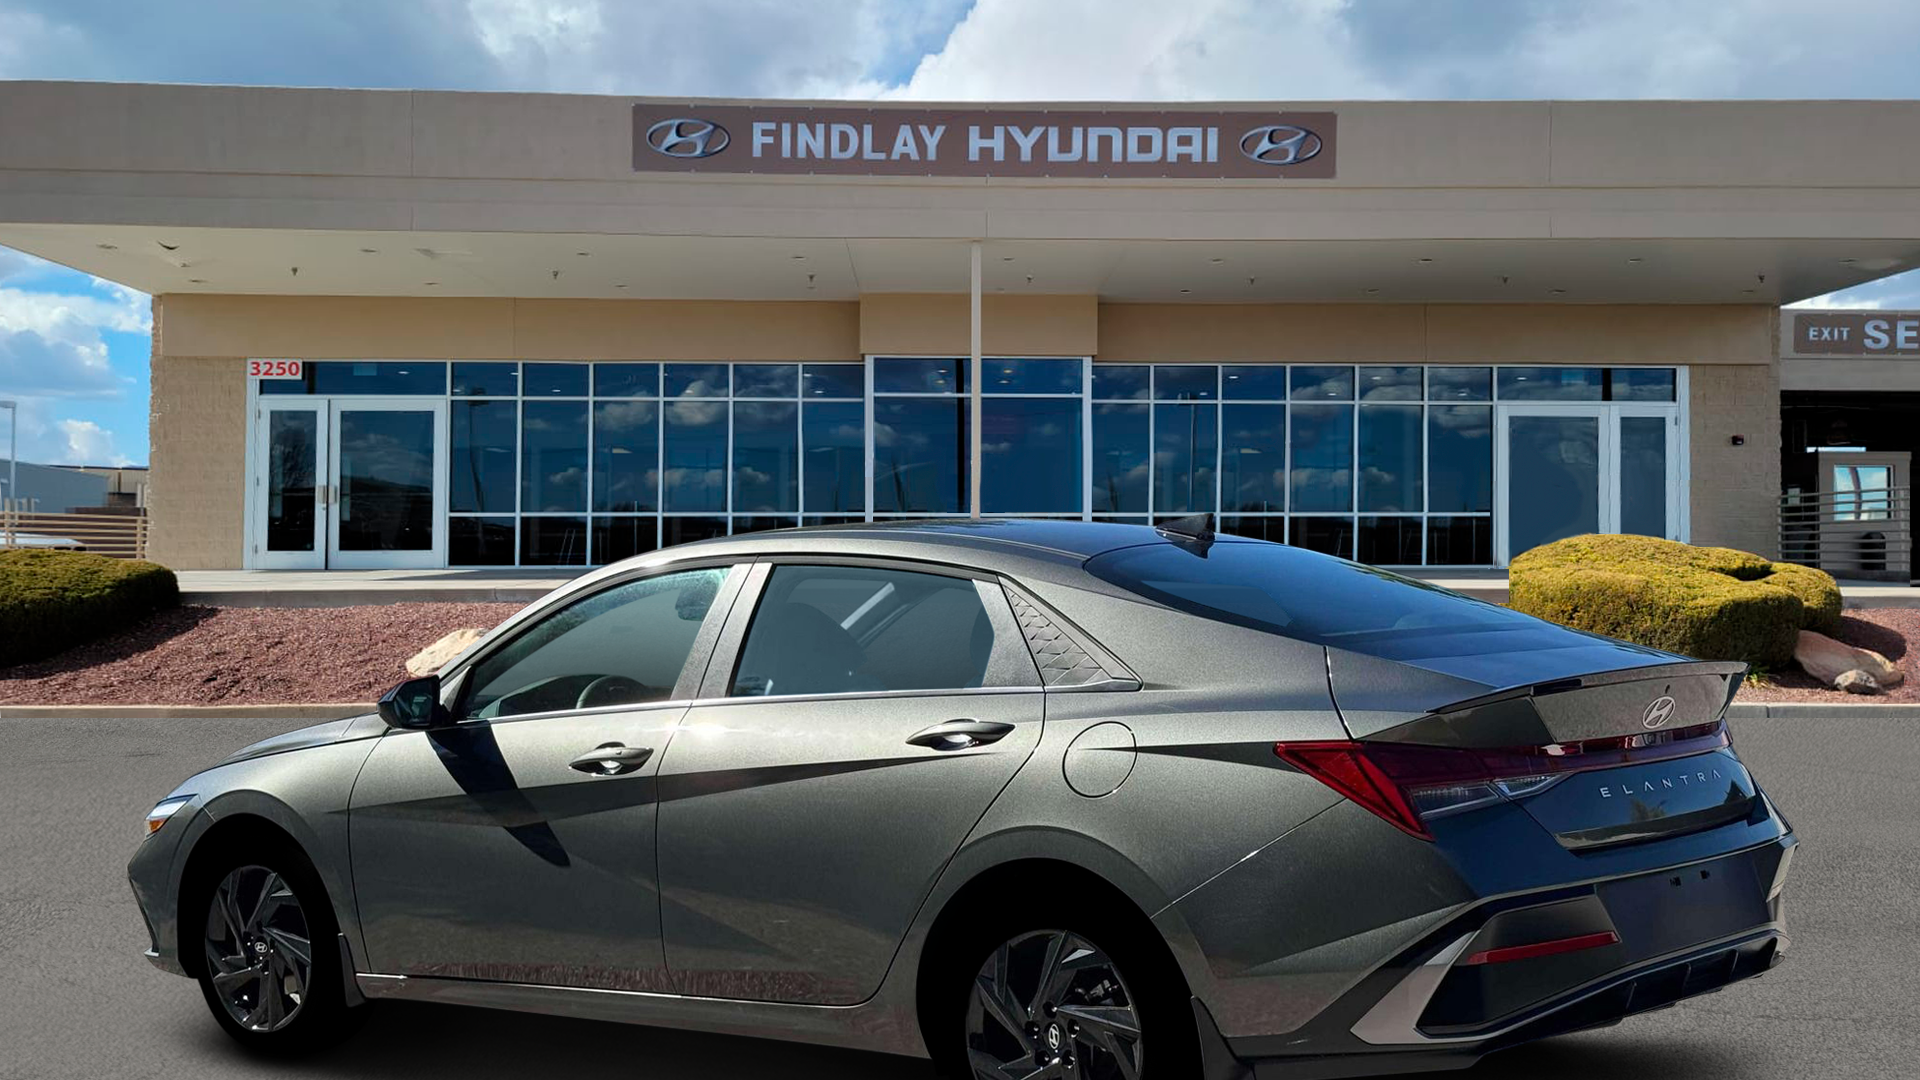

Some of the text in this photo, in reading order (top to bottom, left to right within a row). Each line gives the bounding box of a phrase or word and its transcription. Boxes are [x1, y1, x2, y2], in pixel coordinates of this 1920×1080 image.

[751, 121, 1218, 163] FINDLAY HYUNDAI
[1809, 326, 1850, 341] EXIT
[250, 361, 300, 376] 3250
[1600, 769, 1721, 798] ELANTRA
